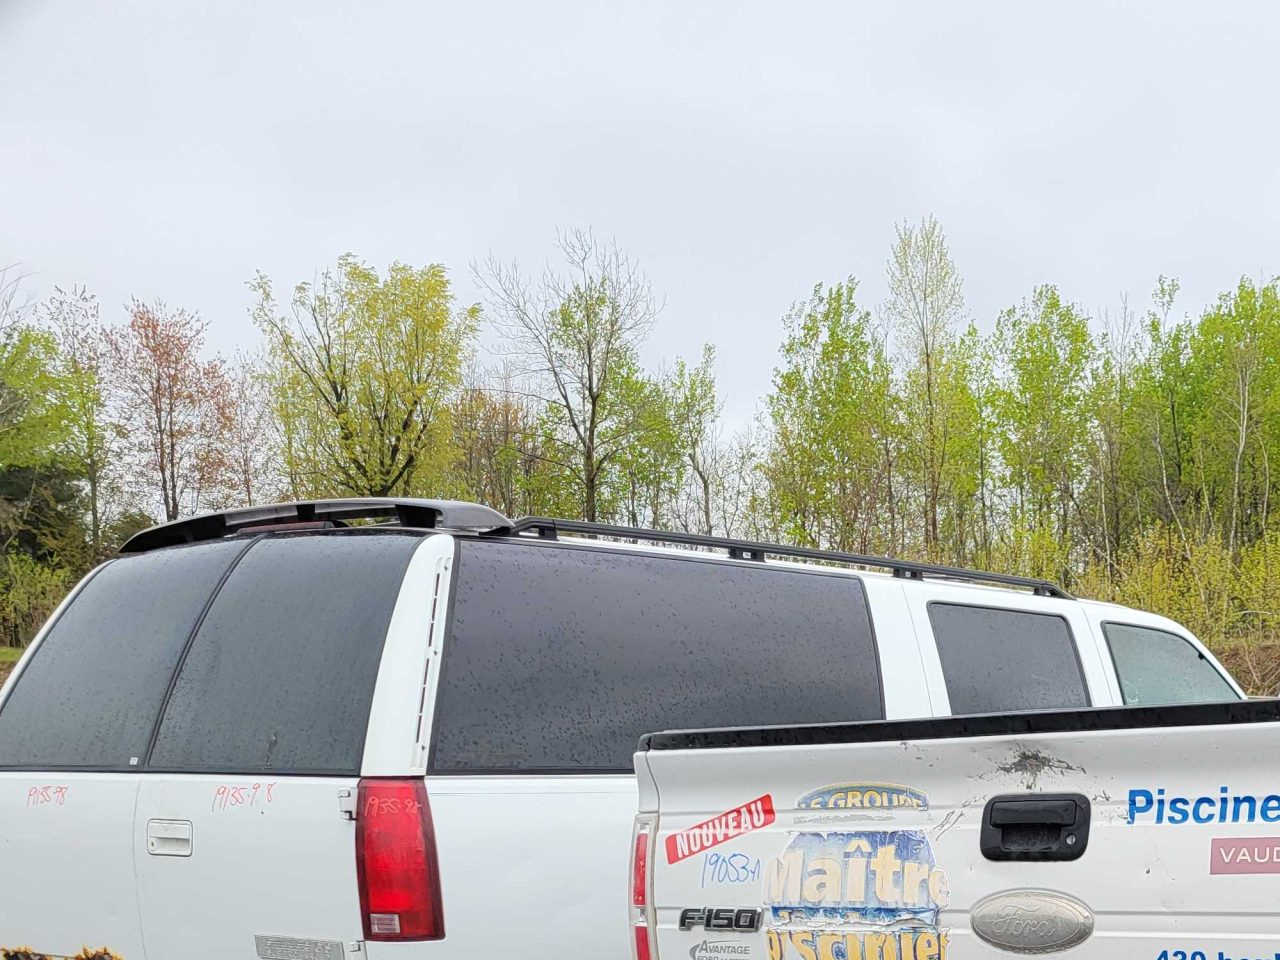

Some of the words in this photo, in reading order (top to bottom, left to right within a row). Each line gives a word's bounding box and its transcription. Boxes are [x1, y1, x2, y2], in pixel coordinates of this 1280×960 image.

[675, 801, 765, 858] NOUVEAU
[993, 904, 1057, 938] Ford
[698, 940, 751, 955] AVANTAGE
